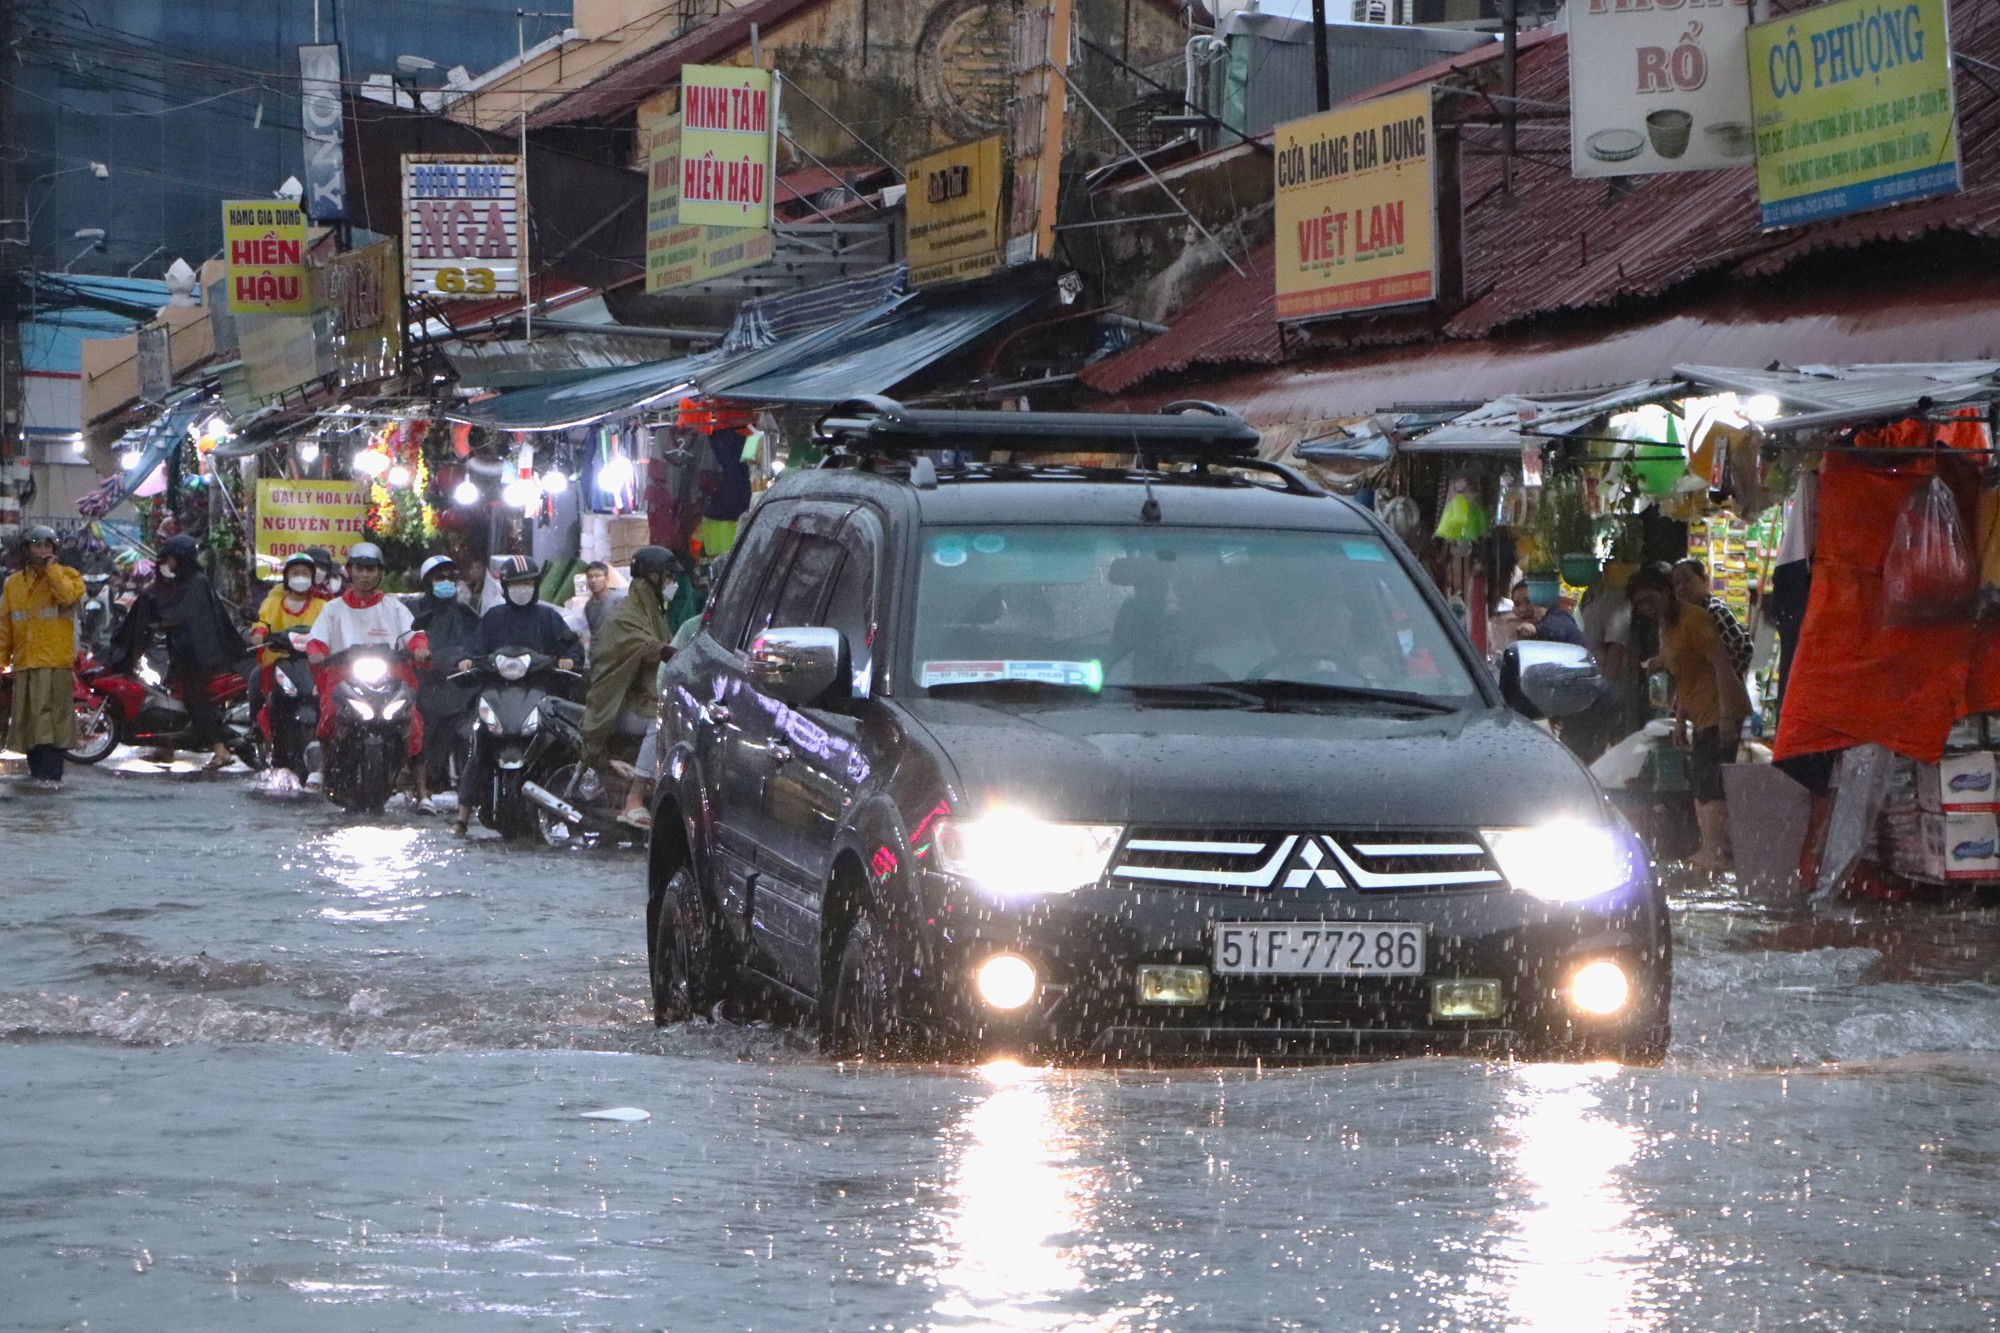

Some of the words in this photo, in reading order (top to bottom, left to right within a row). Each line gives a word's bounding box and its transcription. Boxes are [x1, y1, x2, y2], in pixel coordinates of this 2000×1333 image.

[1636, 19, 1707, 94] RỔ
[1769, 24, 1802, 99] CÔ
[1811, 4, 1924, 88] PHƯỢNG
[306, 53, 343, 211] SONY
[686, 85, 729, 131] MINH
[732, 80, 767, 133] TÂM
[415, 160, 459, 197] ĐIỆN
[1278, 135, 1306, 189] CỬA
[1310, 132, 1348, 181] HÀNG
[1353, 128, 1378, 172] GIA
[1383, 115, 1426, 171] DỤNG
[684, 150, 724, 202] HIỀN
[728, 154, 764, 213] HẬU
[230, 206, 254, 226] HÀNG
[257, 210, 273, 226] GIA
[276, 209, 301, 229] DỤNG
[416, 201, 512, 258] NGA
[1298, 205, 1348, 270] VIỆT
[1355, 200, 1405, 254] LAN
[232, 231, 301, 266] HIỀN
[236, 270, 301, 307] HẬU
[435, 267, 496, 294] 63
[316, 492, 342, 505] HOA
[1223, 931, 1417, 969] 51F-772.86
